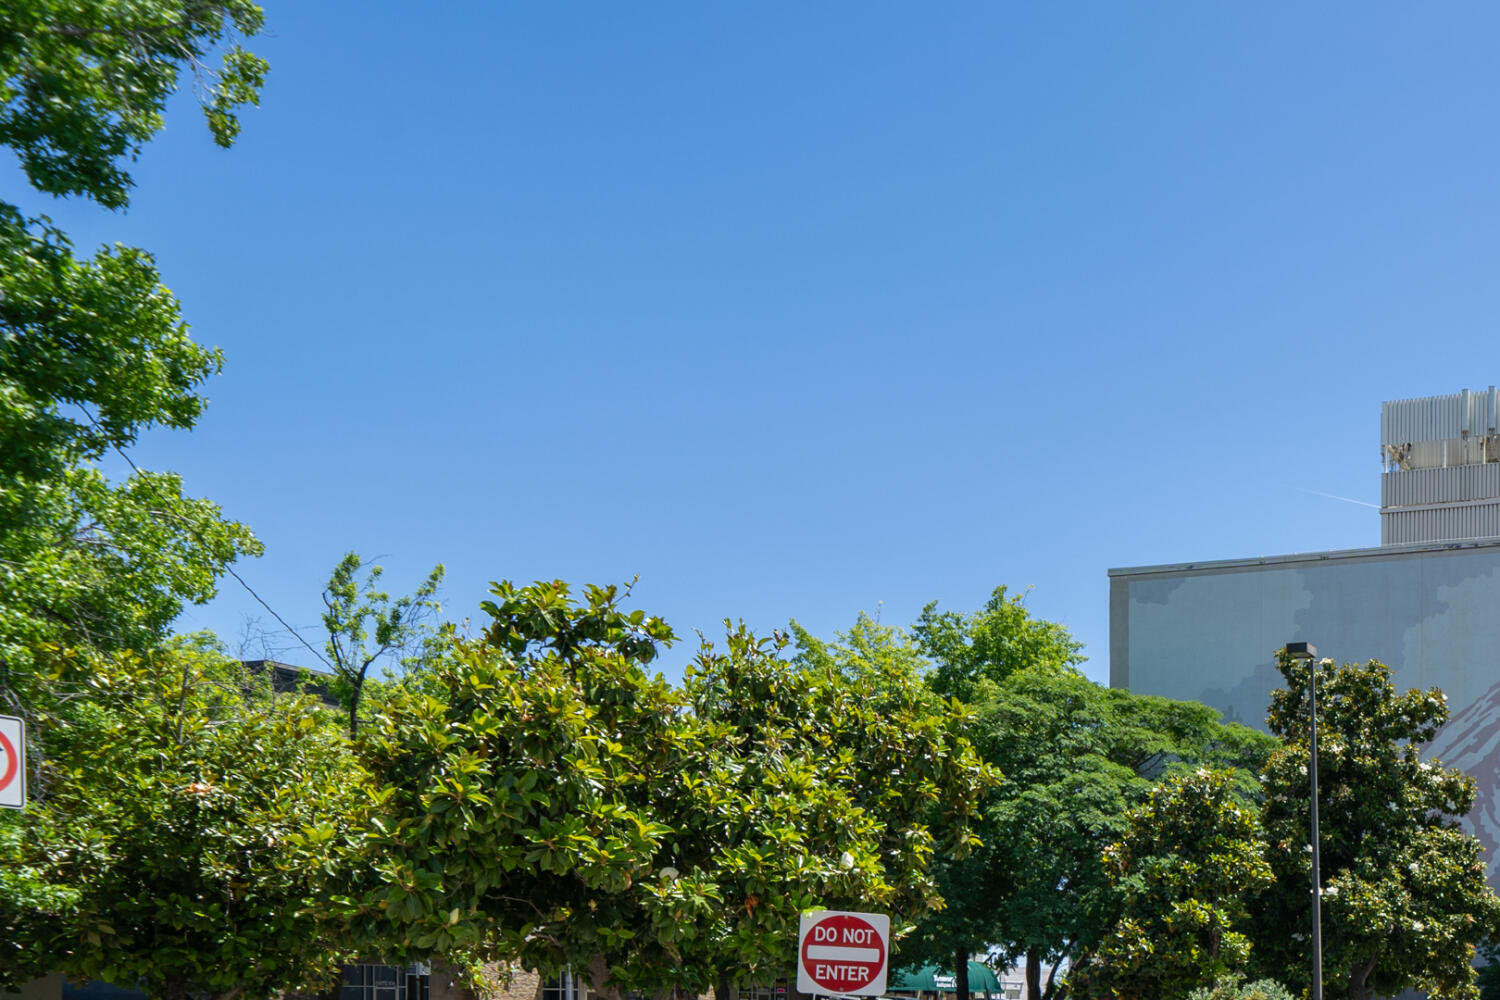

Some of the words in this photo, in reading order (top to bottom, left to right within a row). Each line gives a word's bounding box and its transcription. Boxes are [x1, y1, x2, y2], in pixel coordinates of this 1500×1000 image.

[814, 926, 837, 943] DO
[842, 928, 875, 944] NOT
[815, 964, 870, 982] ENTER
